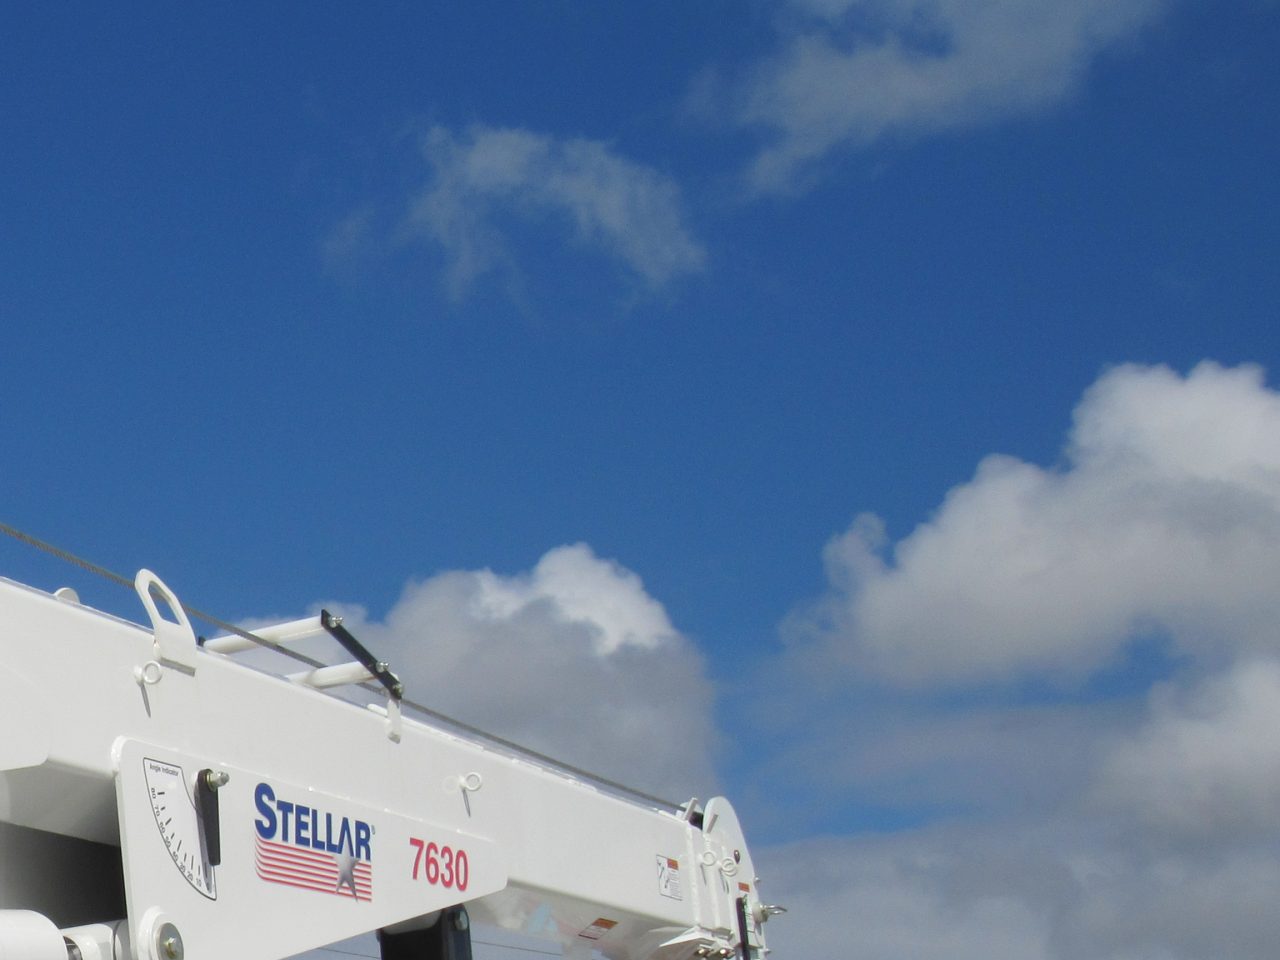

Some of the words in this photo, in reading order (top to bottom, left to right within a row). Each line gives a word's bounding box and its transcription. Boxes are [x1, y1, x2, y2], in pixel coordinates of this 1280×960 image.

[154, 805, 161, 817] 70
[254, 782, 372, 862] STELLAR
[409, 837, 469, 892] 7630
